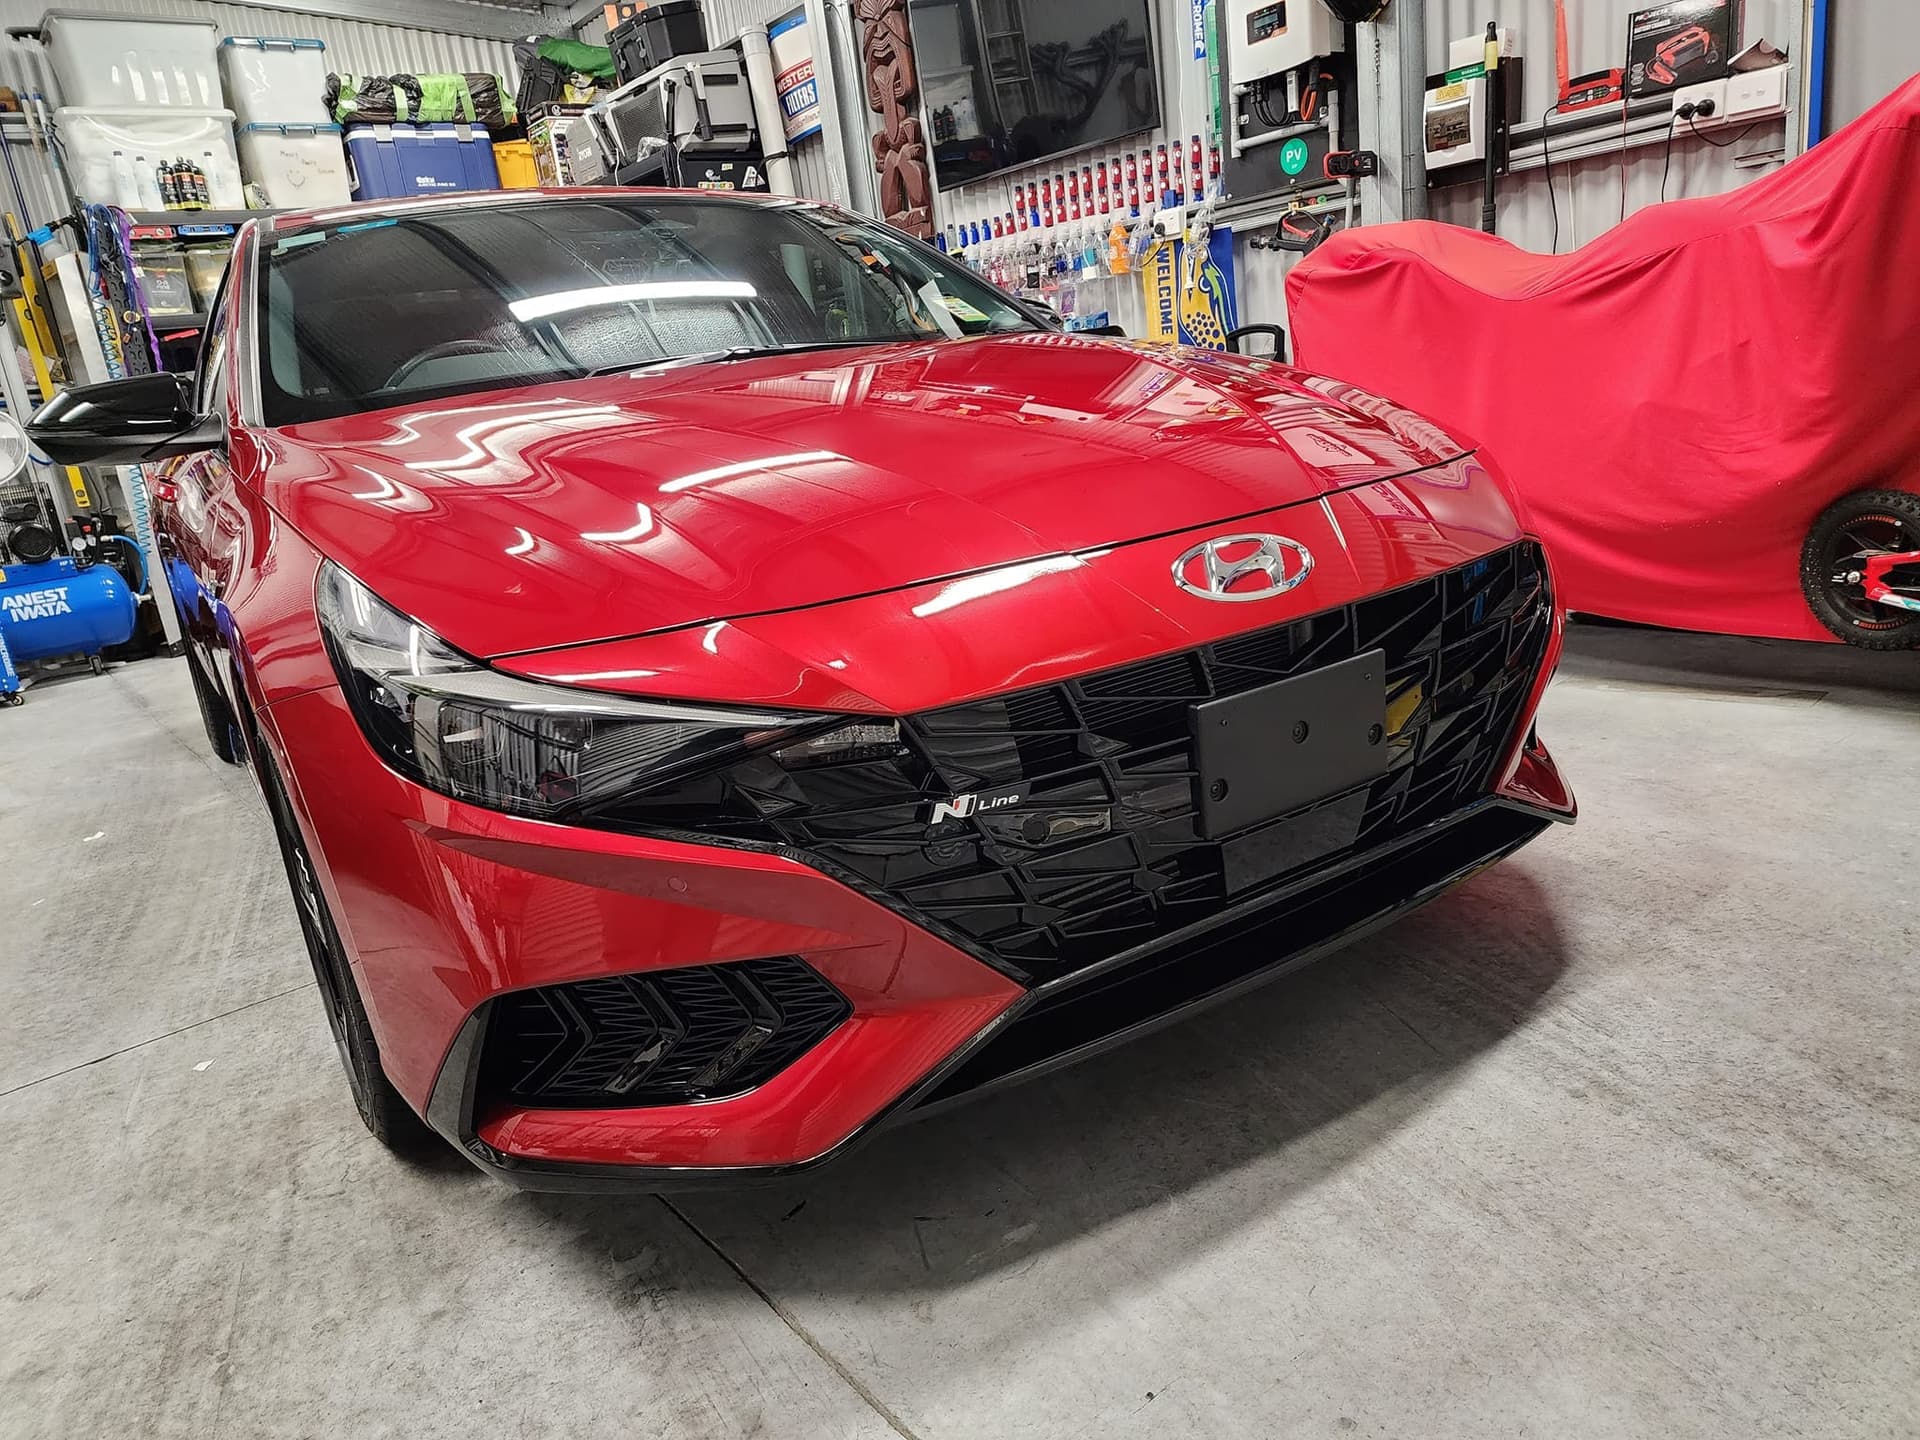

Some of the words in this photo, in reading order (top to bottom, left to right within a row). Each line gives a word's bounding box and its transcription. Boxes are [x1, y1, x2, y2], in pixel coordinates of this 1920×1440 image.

[785, 82, 816, 115] FILTERS
[1286, 147, 1302, 163] PV
[1157, 247, 1173, 335] WELCOME
[2, 587, 69, 610] ANEST
[10, 601, 72, 622] IWATA
[979, 795, 1019, 810] Line
